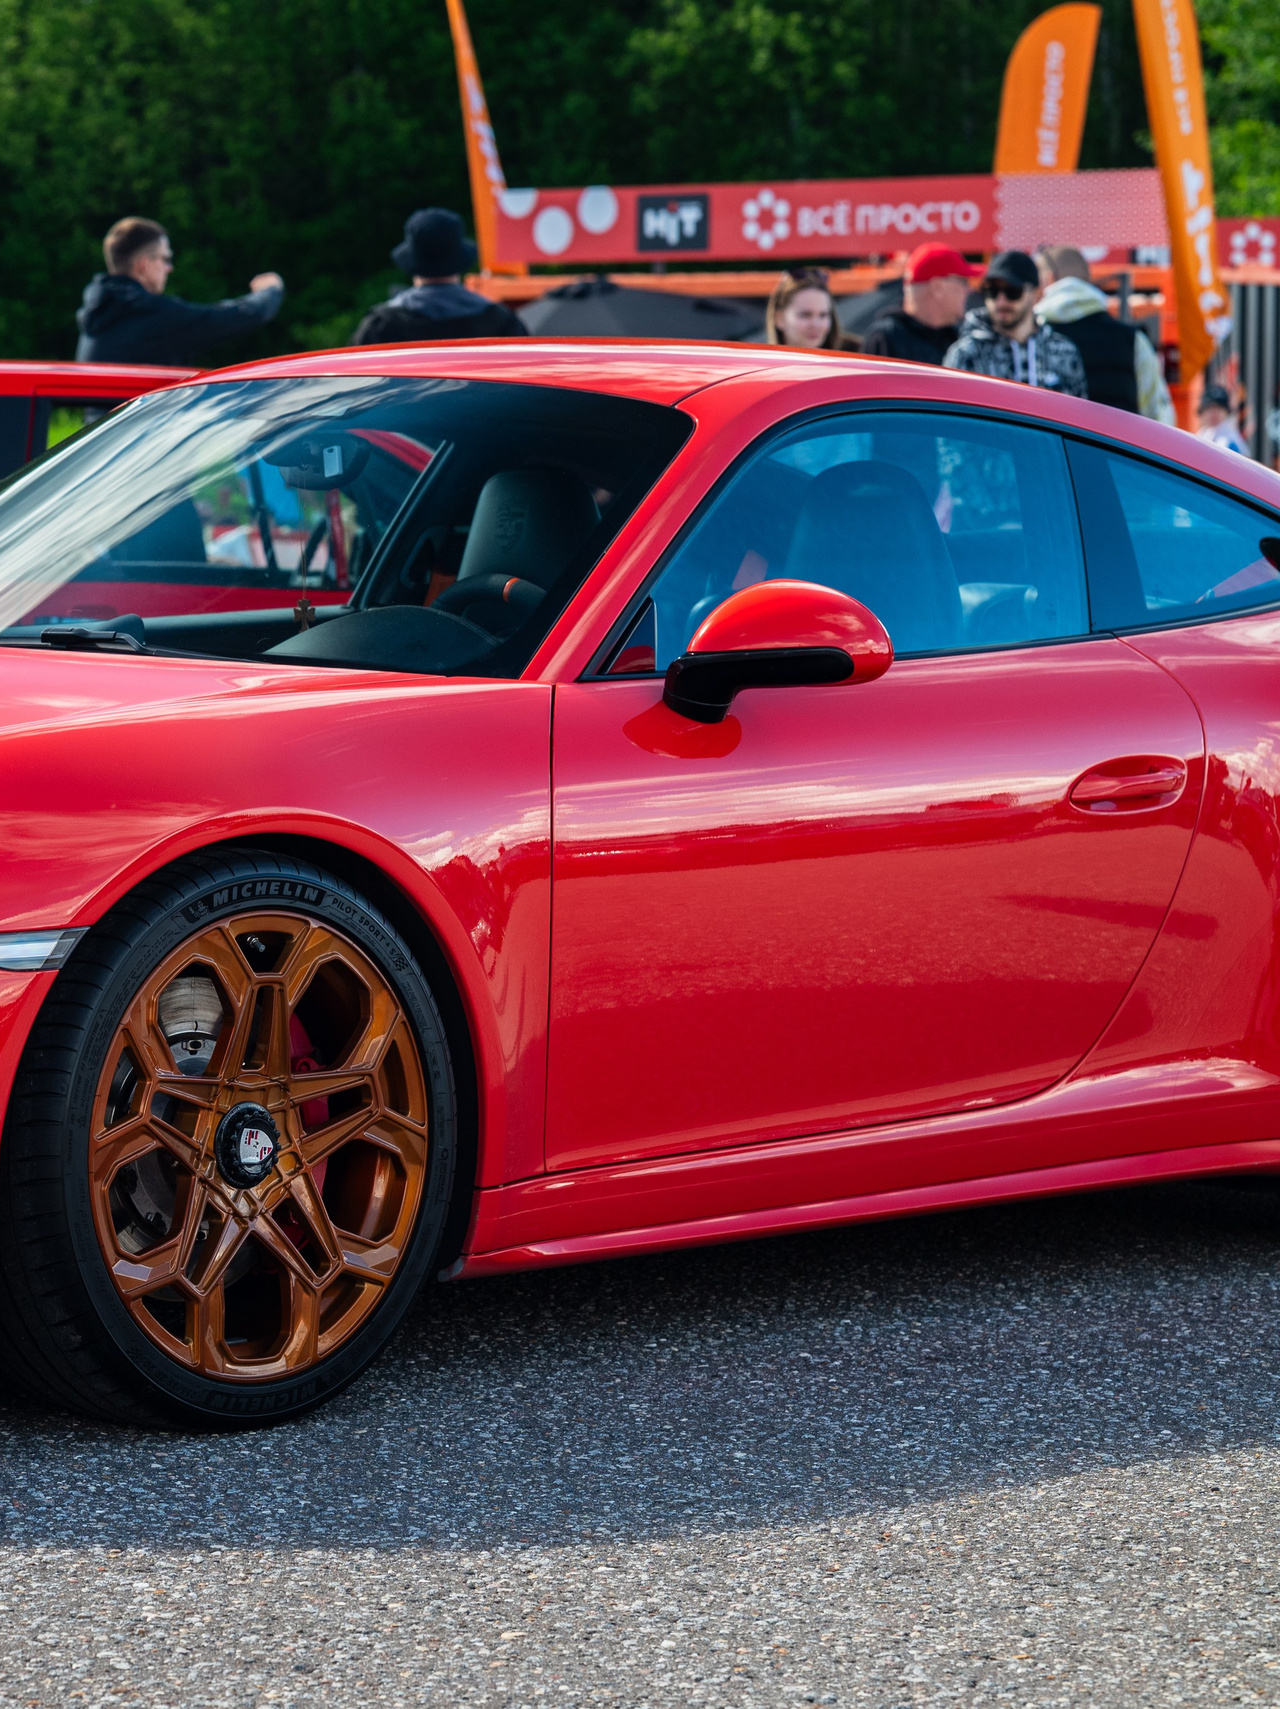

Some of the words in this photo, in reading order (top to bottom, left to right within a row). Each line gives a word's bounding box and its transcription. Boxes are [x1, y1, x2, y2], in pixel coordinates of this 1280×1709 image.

[797, 200, 850, 237] ВСЁ
[854, 200, 981, 236] ПРОСТО
[213, 881, 319, 908] MICHELIN
[331, 897, 358, 917] PILOT
[358, 916, 385, 942] SPORT
[208, 1380, 318, 1411] MICHELIN
